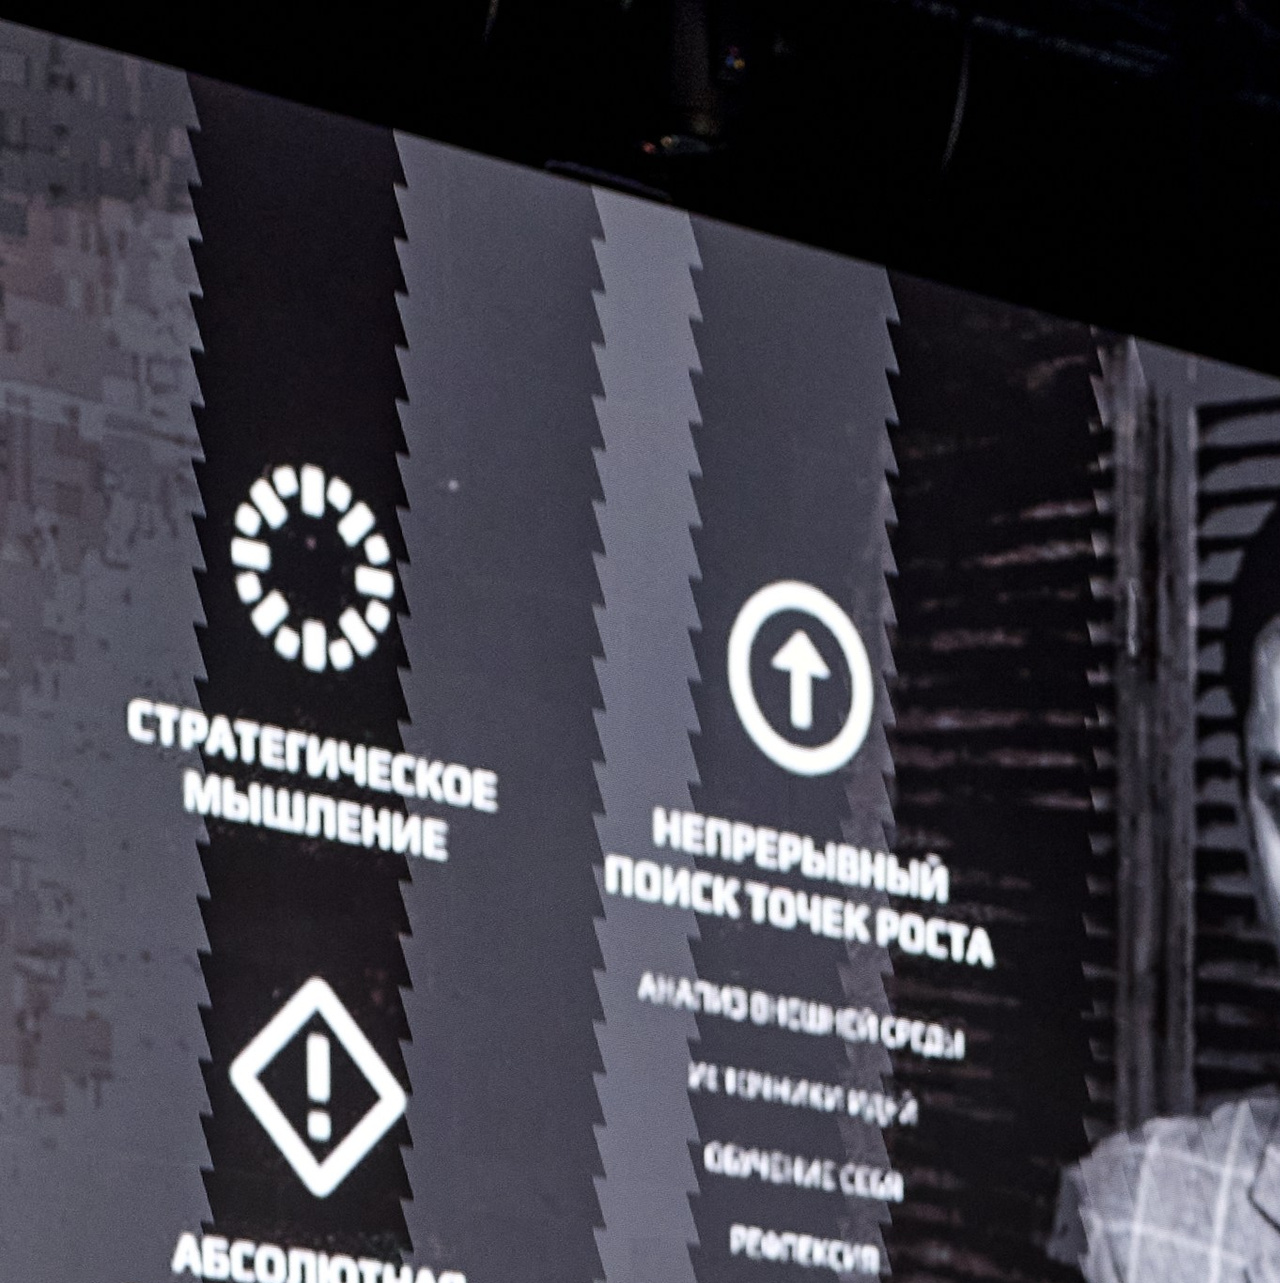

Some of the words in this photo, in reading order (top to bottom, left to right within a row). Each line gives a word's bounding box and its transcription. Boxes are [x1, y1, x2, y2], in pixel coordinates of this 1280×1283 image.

[127, 697, 499, 813] СТРАТЕГИЧЕСКОЕ
[183, 768, 450, 863] МЫШЛЕНИЕ
[652, 806, 951, 904] НЕПРЕРЫВНЫЙ
[604, 853, 742, 920] ПОИСК
[744, 880, 873, 944] ТОЧЕК
[873, 906, 996, 970] РОСТА
